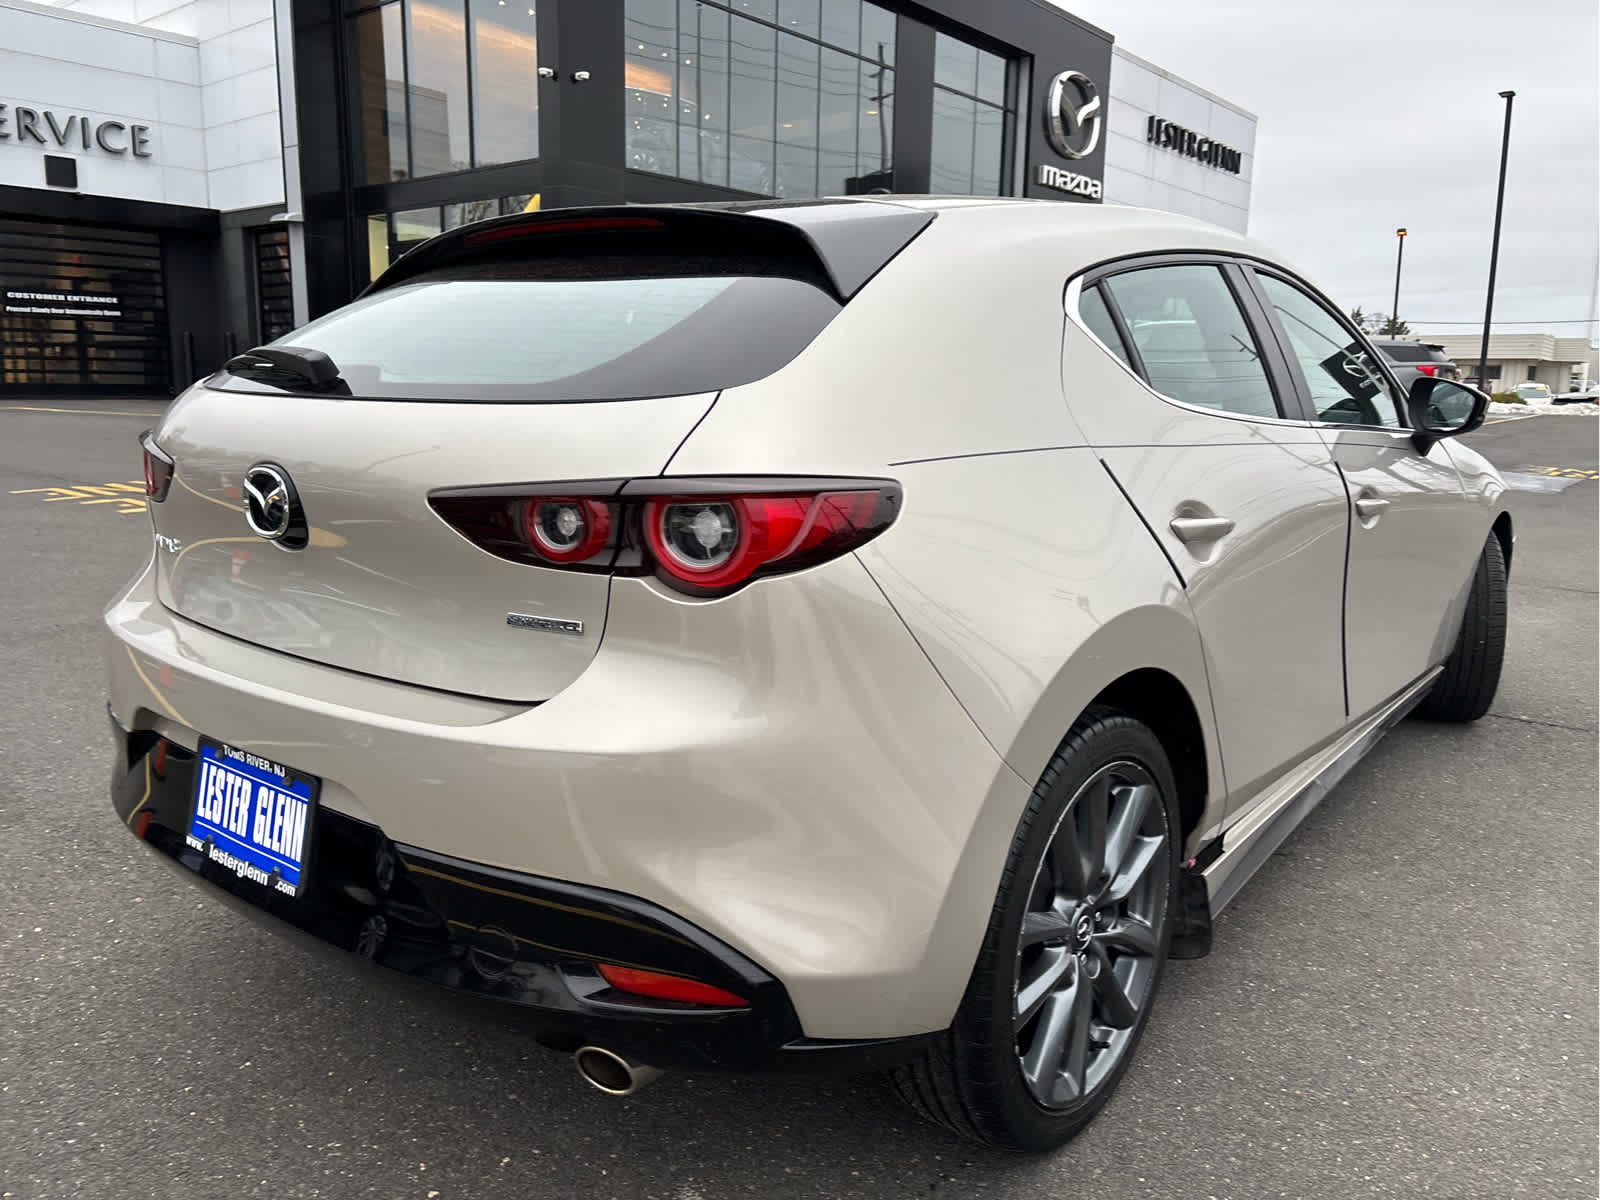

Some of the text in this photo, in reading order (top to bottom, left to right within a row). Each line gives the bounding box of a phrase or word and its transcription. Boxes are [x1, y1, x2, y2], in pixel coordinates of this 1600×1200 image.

[7, 292, 119, 304] CUSTOMER ENTRANCE
[223, 744, 245, 763] TOMS
[273, 763, 286, 778] NJ
[197, 762, 308, 863] LESTER GLENN
[209, 844, 268, 886] lesterglenn
